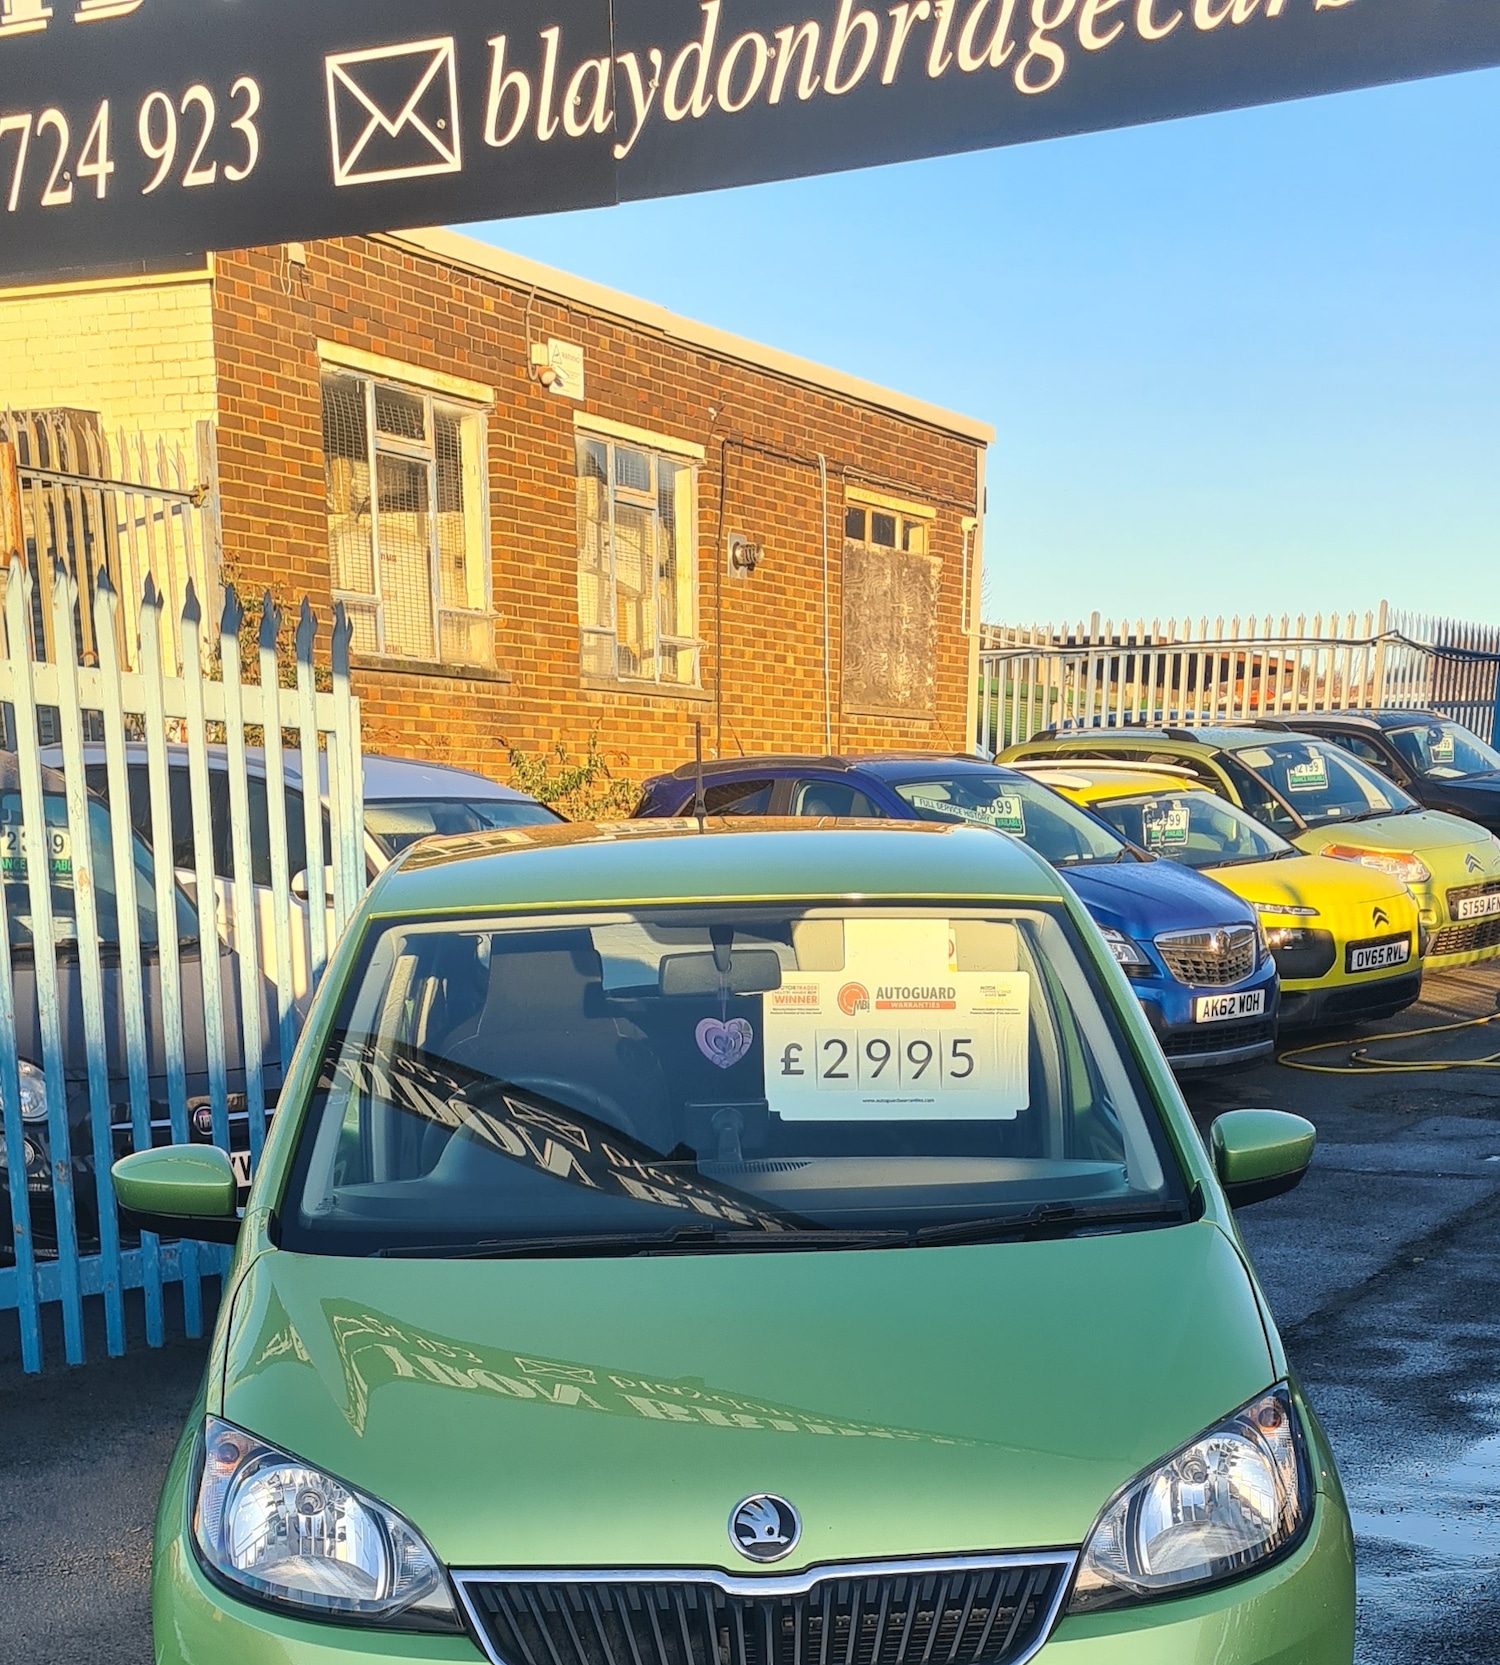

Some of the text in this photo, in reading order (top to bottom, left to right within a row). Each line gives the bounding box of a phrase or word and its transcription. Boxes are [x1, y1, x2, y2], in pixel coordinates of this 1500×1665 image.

[483, 0, 1356, 160] blaydonbridgec
[138, 77, 262, 196] 923
[919, 798, 991, 823] FULL SERVICE HISTORY
[1462, 899, 1485, 916] ST59
[1356, 944, 1404, 967] OV65 RVL
[774, 995, 818, 1004] WINNER
[876, 986, 956, 1000] AUTOGUARD
[890, 1001, 941, 1009] WARRANTIES
[1202, 997, 1236, 1018] AK62
